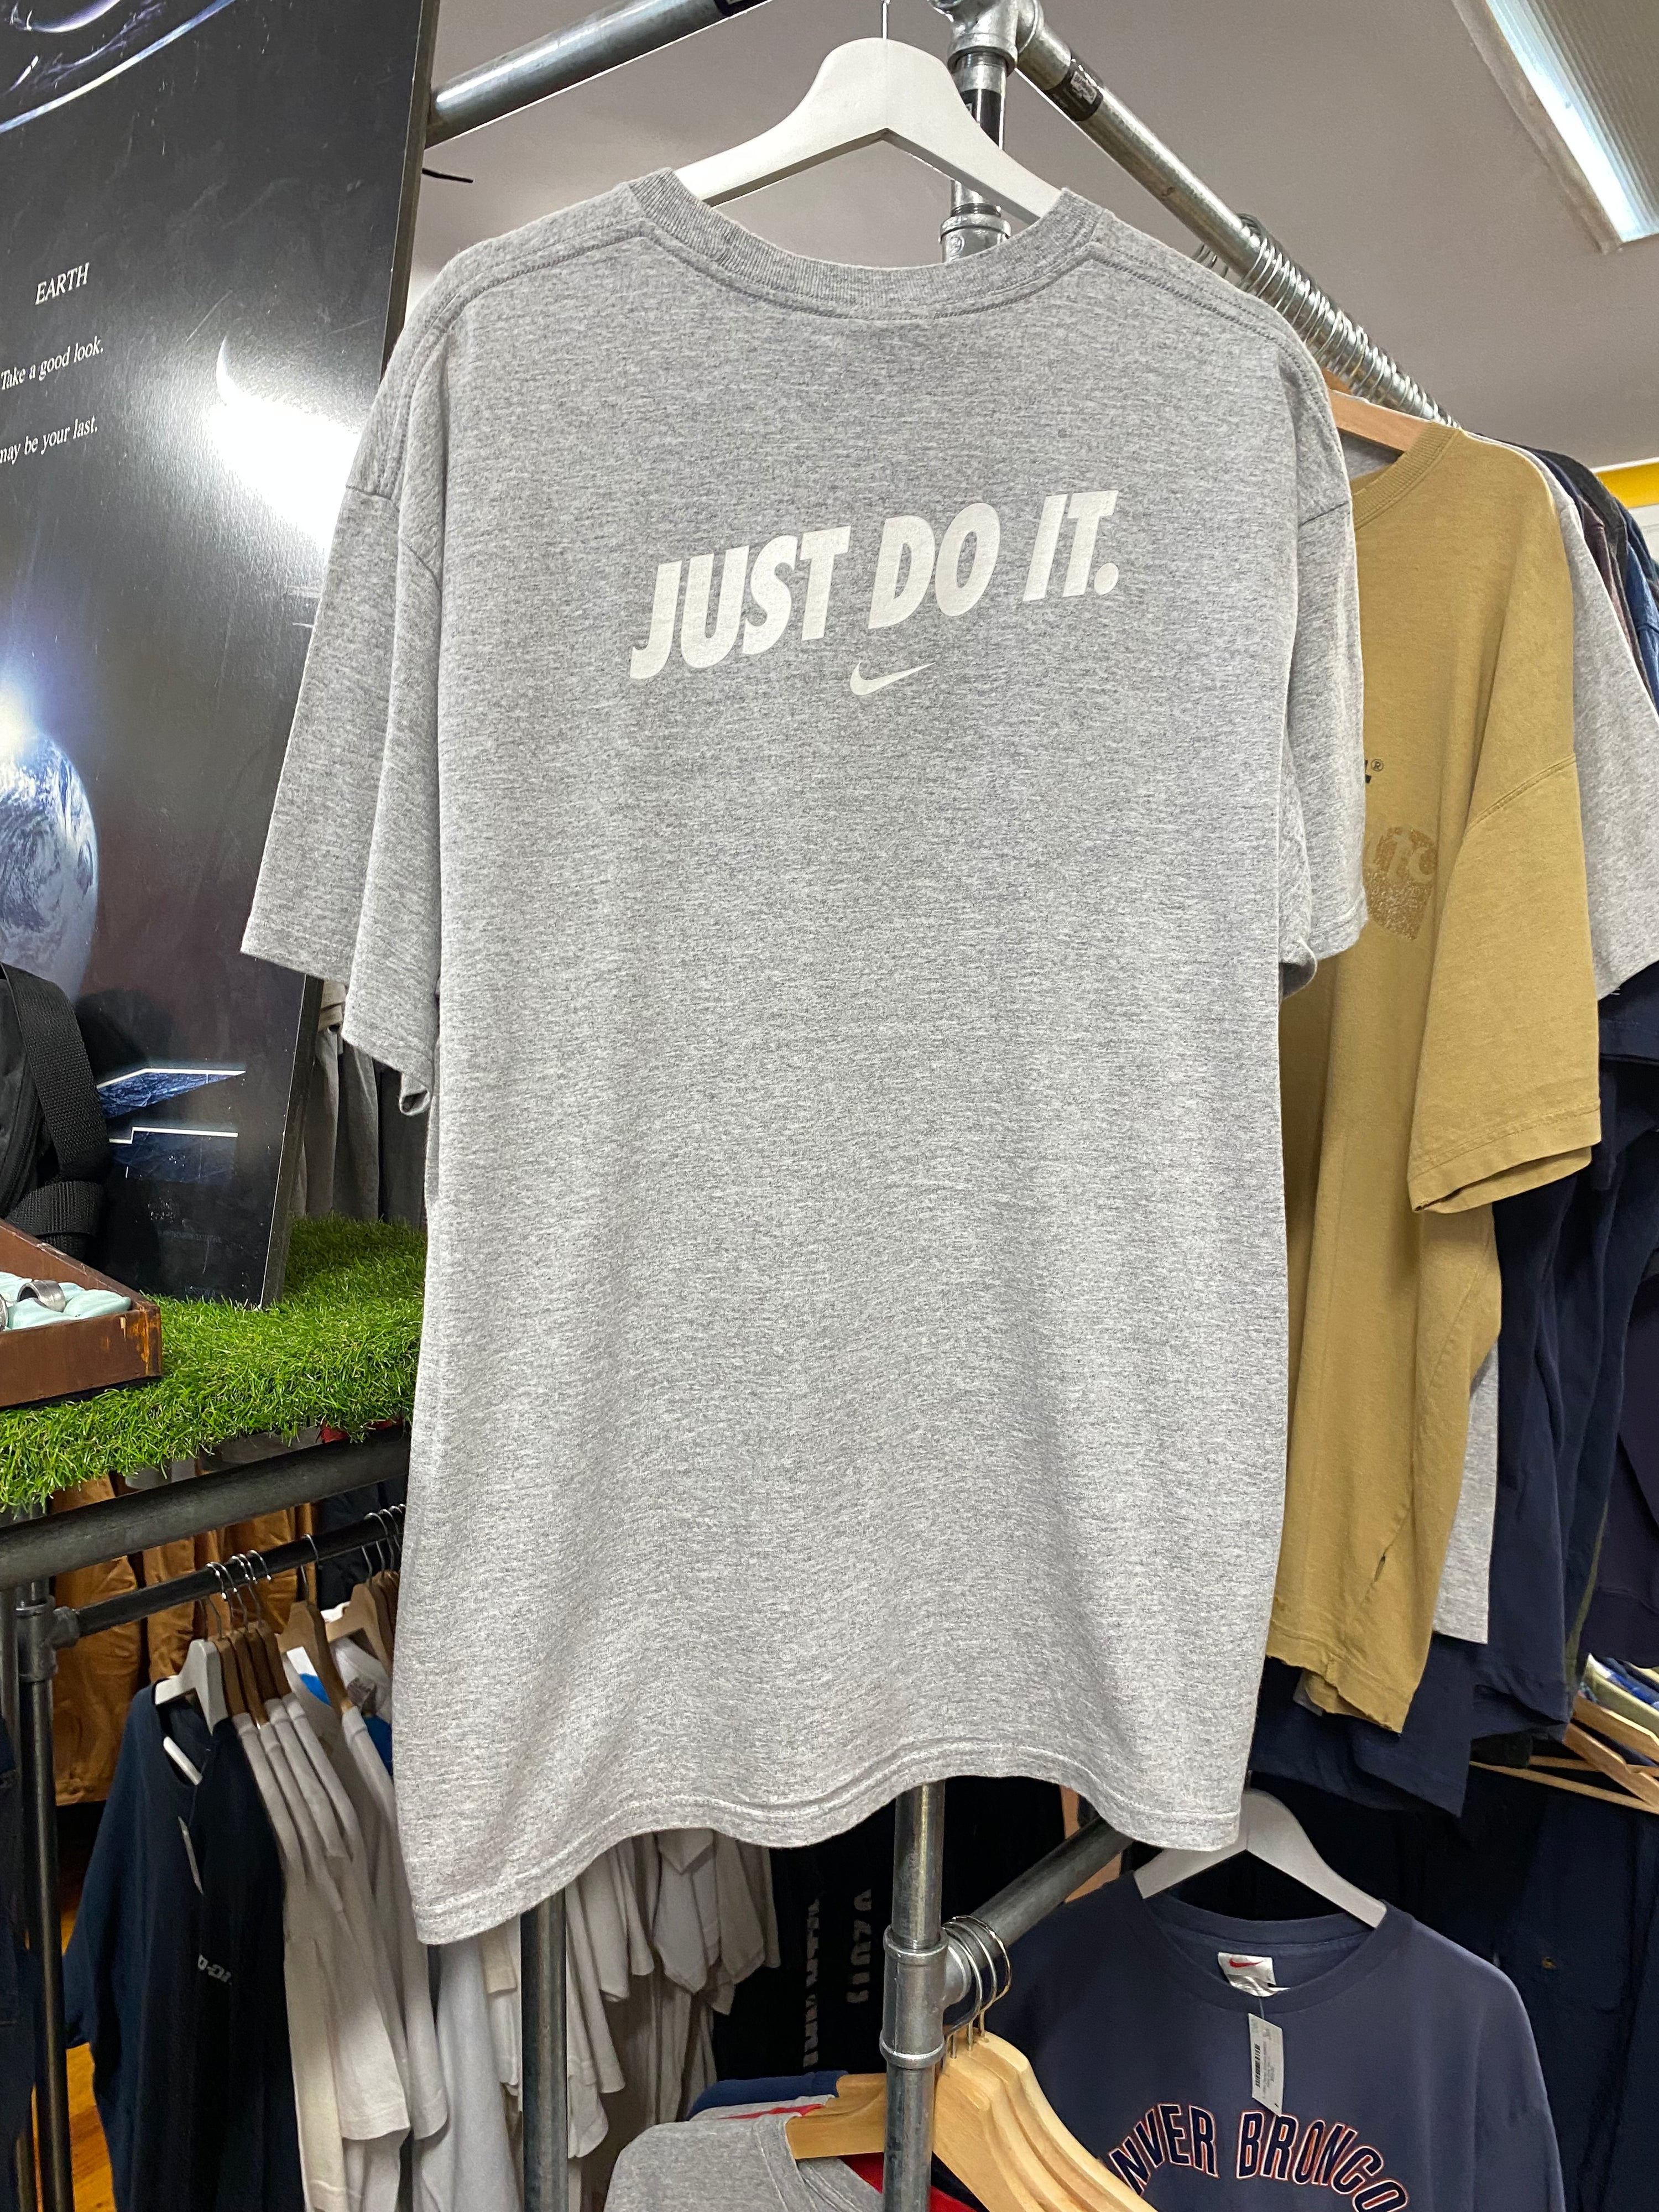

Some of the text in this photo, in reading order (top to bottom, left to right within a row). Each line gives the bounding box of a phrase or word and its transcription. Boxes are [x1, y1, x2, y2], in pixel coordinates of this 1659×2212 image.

[35, 262, 90, 305] EARTH
[1, 336, 104, 389] Take a good look.
[24, 436, 38, 455] be
[40, 425, 70, 455] your
[72, 415, 98, 439] last.
[629, 489, 1119, 680] JUST DO IT.
[1108, 2103, 1409, 2212] NVER BRONCO
